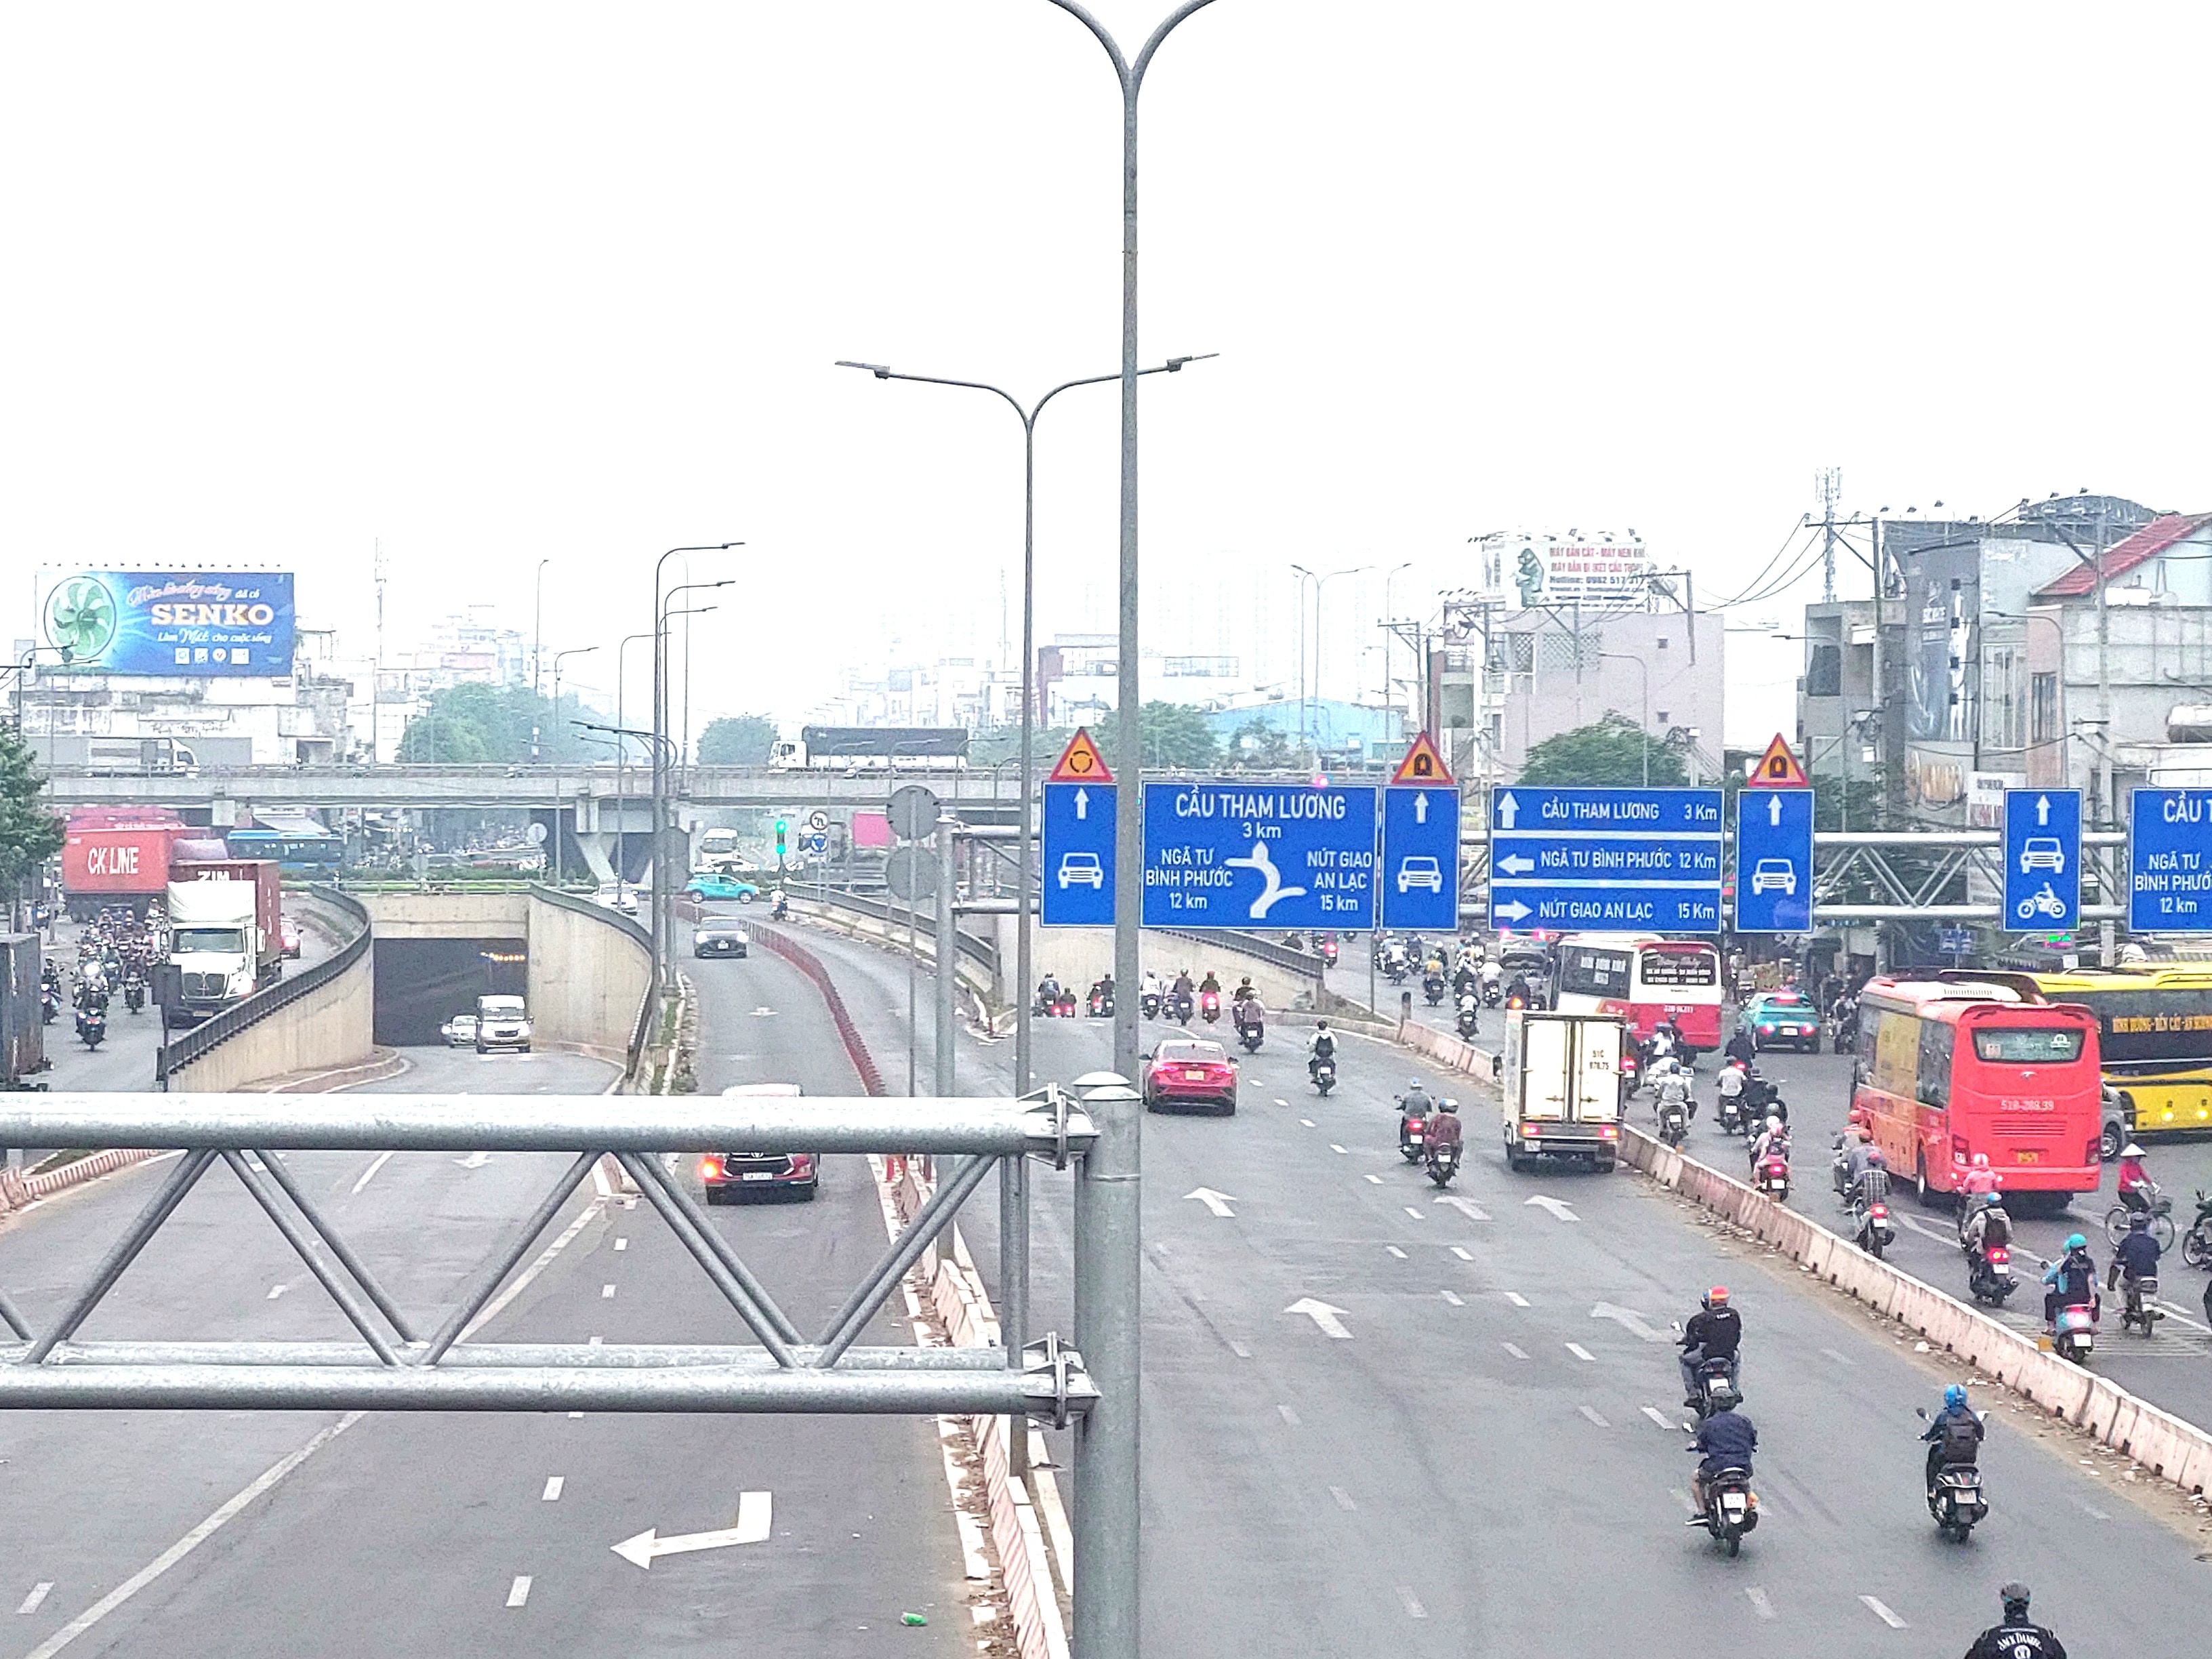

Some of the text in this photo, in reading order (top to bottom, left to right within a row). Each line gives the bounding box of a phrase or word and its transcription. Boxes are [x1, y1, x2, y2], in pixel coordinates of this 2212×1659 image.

[150, 603, 274, 626] SENKO
[1176, 784, 1346, 819] CẦU THAM LƯƠNG
[1542, 796, 1717, 820] CẦU THAM LƯƠNG 3 Km
[2164, 790, 2202, 823] CẦU
[1242, 822, 1282, 838] 3 km
[87, 846, 139, 874] CK LINE
[1162, 846, 1214, 865] NGÃ TƯ
[1307, 848, 1372, 867] NÚT GIAO
[1541, 847, 1716, 869] NGÃ TƯ BÌNH PHƯỚC 12 Km
[2148, 851, 2201, 870] NGÃ TƯ
[1145, 865, 1233, 886] BÌNH PHƯỚC
[1314, 873, 1368, 893] AN LẠC
[2135, 871, 2212, 891] BÌNH PHƯỚ
[1170, 893, 1208, 909] 12 km
[1320, 894, 1358, 911] 15 km
[1540, 899, 1715, 922] NÚT GIAO AN LẠC 15 Km
[2160, 896, 2198, 914] 12 km
